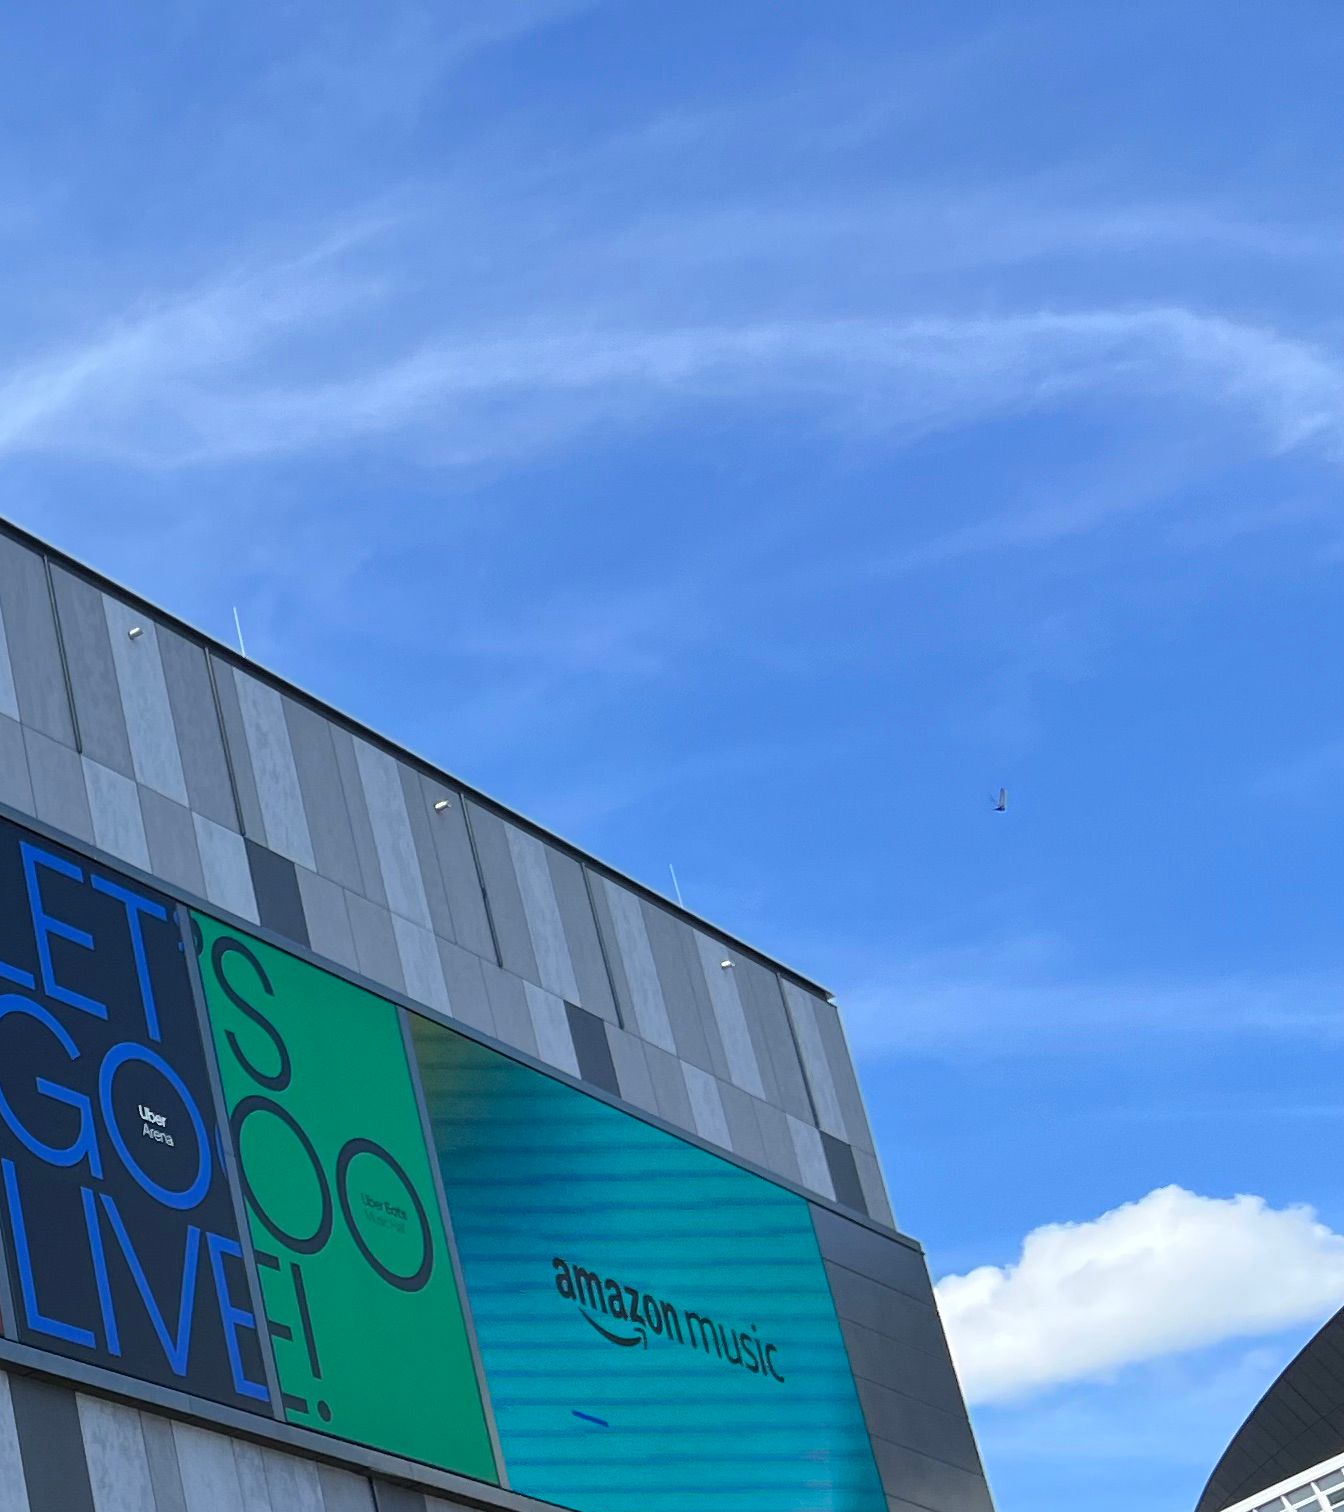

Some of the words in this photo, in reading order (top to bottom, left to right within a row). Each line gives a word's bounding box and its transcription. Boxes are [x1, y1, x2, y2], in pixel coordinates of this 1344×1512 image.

[138, 1104, 167, 1127] Uber
[142, 1122, 174, 1147] Arena
[552, 1256, 684, 1346] amazon
[684, 1311, 785, 1384] music
